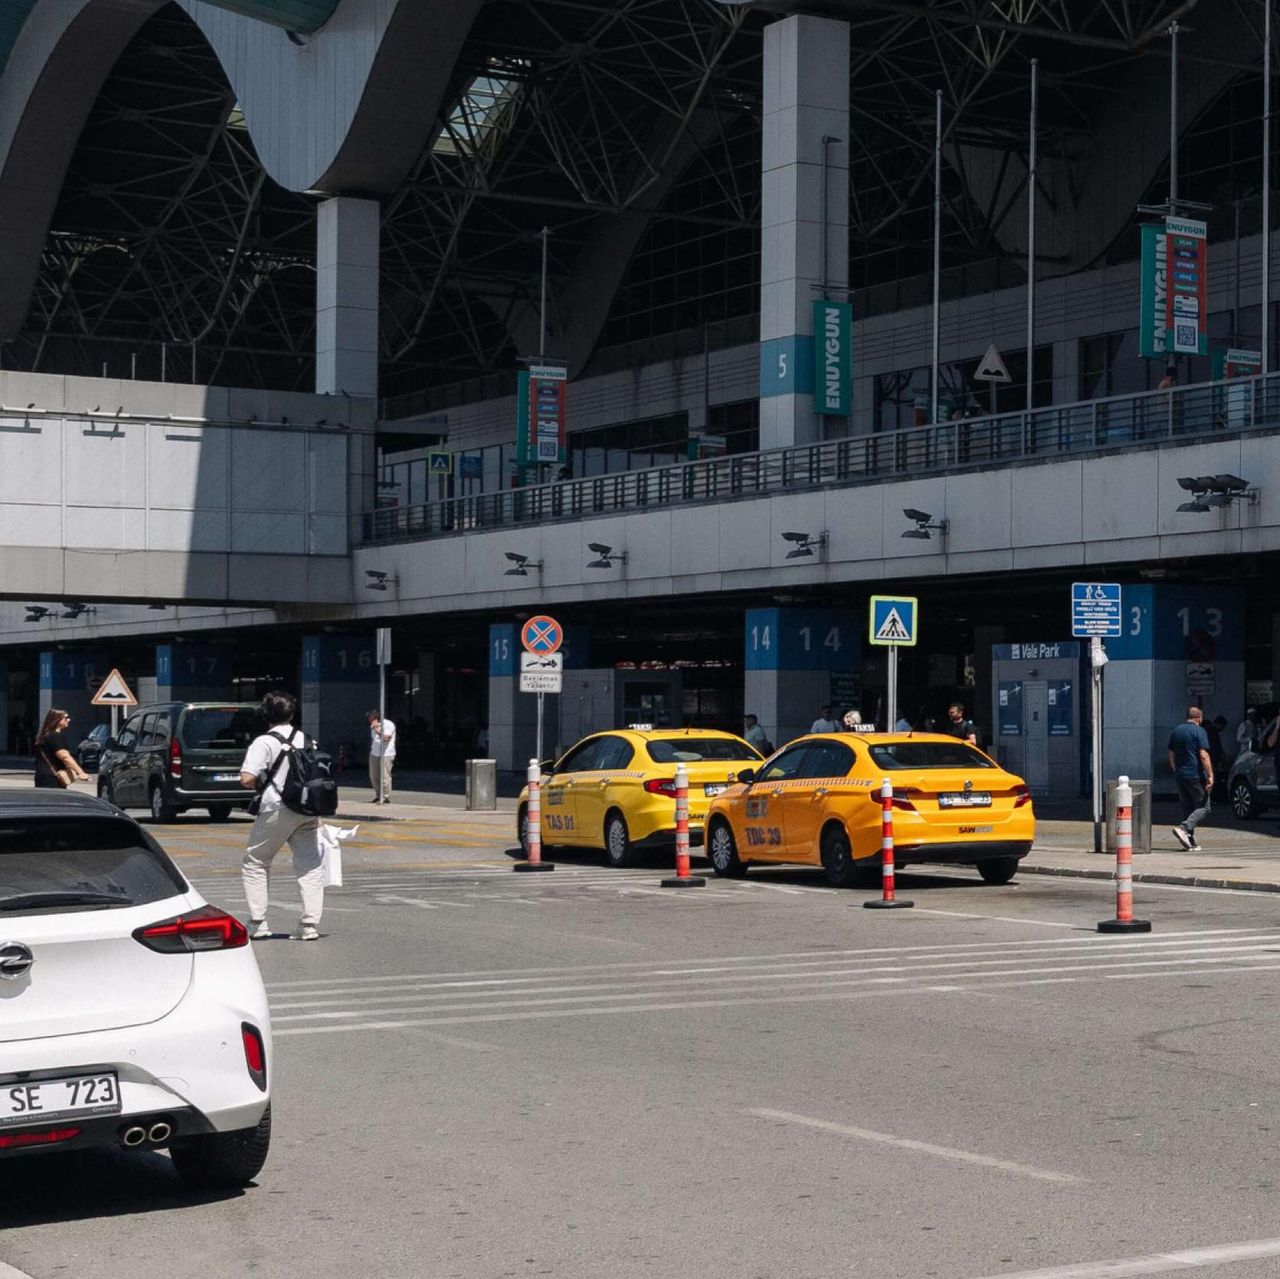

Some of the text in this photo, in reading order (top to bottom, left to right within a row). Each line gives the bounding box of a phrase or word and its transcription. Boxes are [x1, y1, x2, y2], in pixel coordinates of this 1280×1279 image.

[1167, 222, 1205, 236] ENUYGUN
[779, 353, 787, 378] 5
[826, 307, 841, 409] ENUYGUN
[1131, 606, 1144, 636] 3
[494, 639, 508, 661] 15
[752, 625, 771, 651] 14
[1021, 641, 1059, 659] Vale Park
[10, 1077, 114, 1112] SE 723
